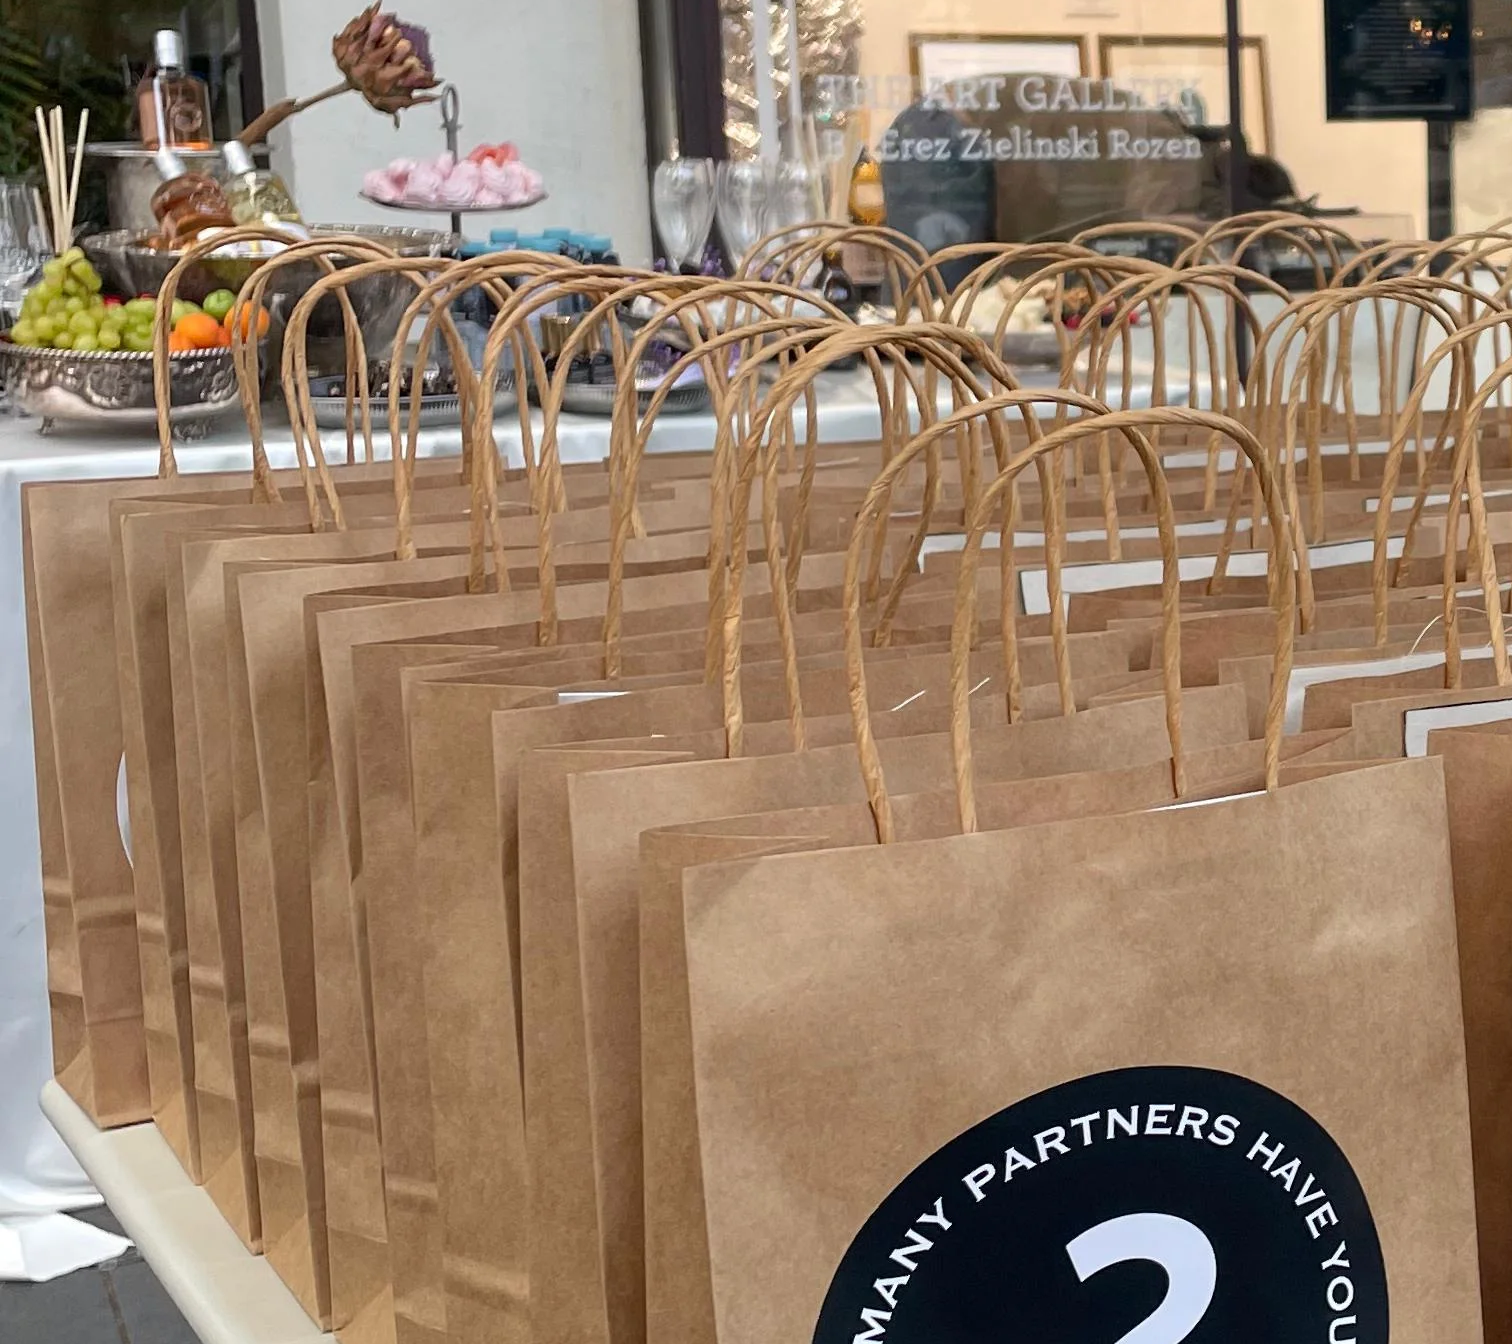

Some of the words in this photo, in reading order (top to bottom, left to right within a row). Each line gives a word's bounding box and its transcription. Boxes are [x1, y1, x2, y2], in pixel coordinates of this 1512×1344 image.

[923, 74, 1007, 112] ART
[1015, 74, 1203, 112] GALLERY
[880, 128, 952, 162] Erez
[960, 125, 1101, 160] Zielinski
[1108, 128, 1204, 161] Rozen
[961, 1103, 1241, 1203] PARTNERS
[1245, 1131, 1340, 1240] HAVE
